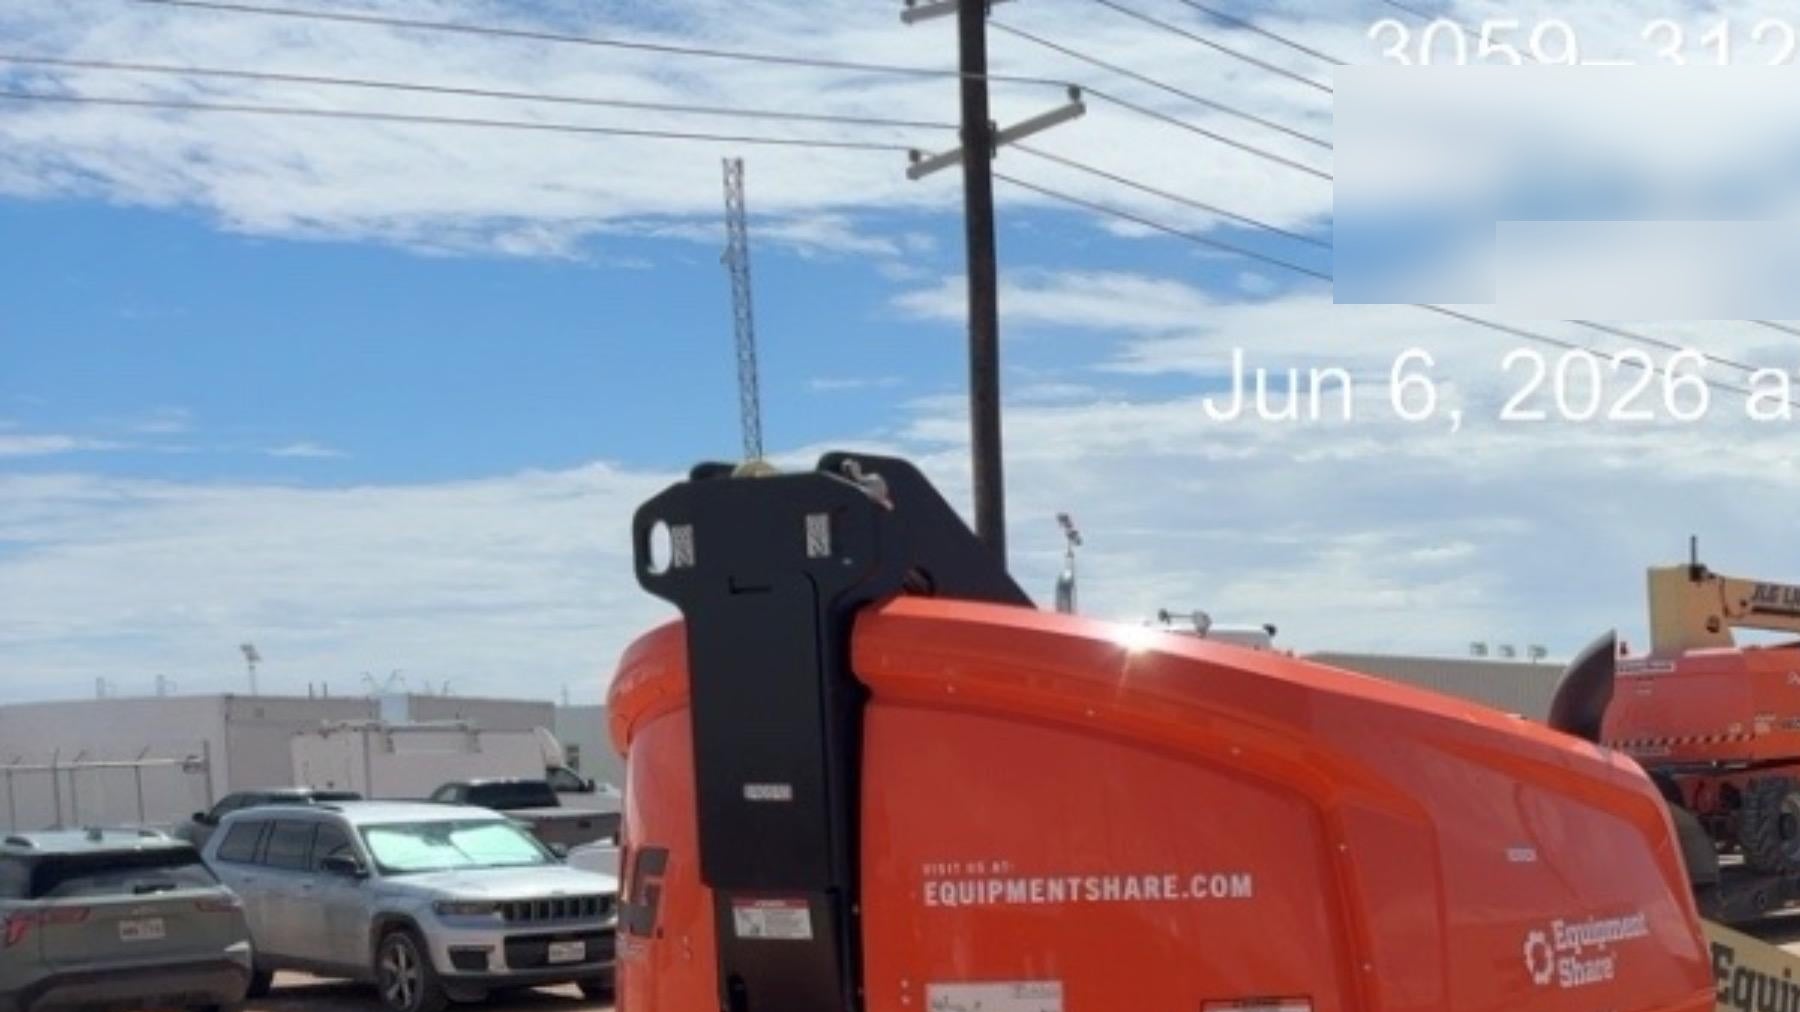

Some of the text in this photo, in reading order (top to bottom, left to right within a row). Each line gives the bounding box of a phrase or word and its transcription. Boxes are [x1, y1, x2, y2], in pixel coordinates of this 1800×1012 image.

[924, 873, 1252, 906] EQUIPMENTSHARE.COM
[1551, 913, 1649, 955] Equipment
[1557, 954, 1615, 988] Share
